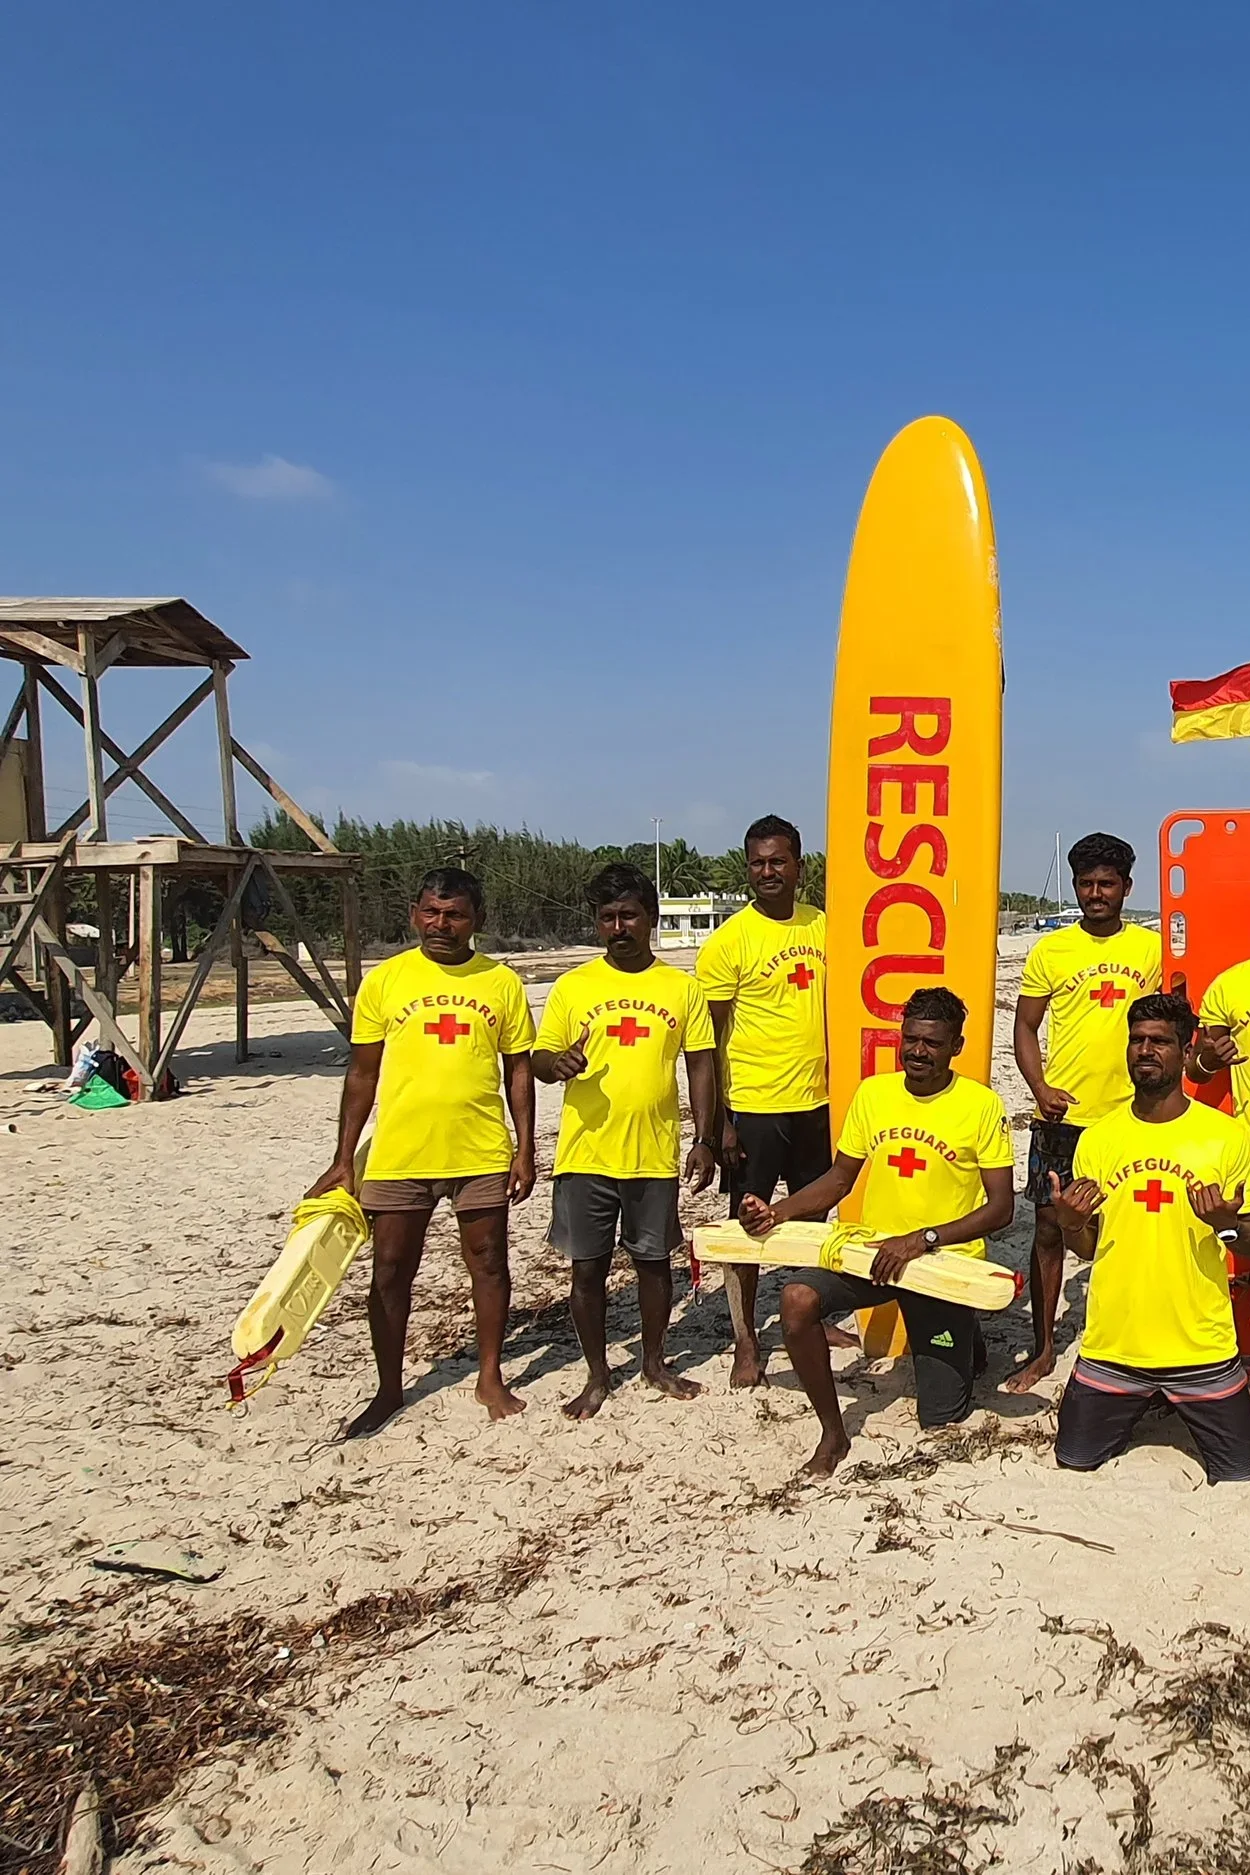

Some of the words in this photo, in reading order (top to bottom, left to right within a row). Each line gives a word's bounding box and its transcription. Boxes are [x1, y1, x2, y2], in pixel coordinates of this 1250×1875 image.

[1065, 963, 1146, 992] LIFEGUARD
[395, 994, 497, 1027] LIFEGUARD
[580, 998, 677, 1029] LIFEGUARD
[869, 1127, 957, 1162] LIFEGUARD
[1106, 1157, 1204, 1192] LIFEGUARD
